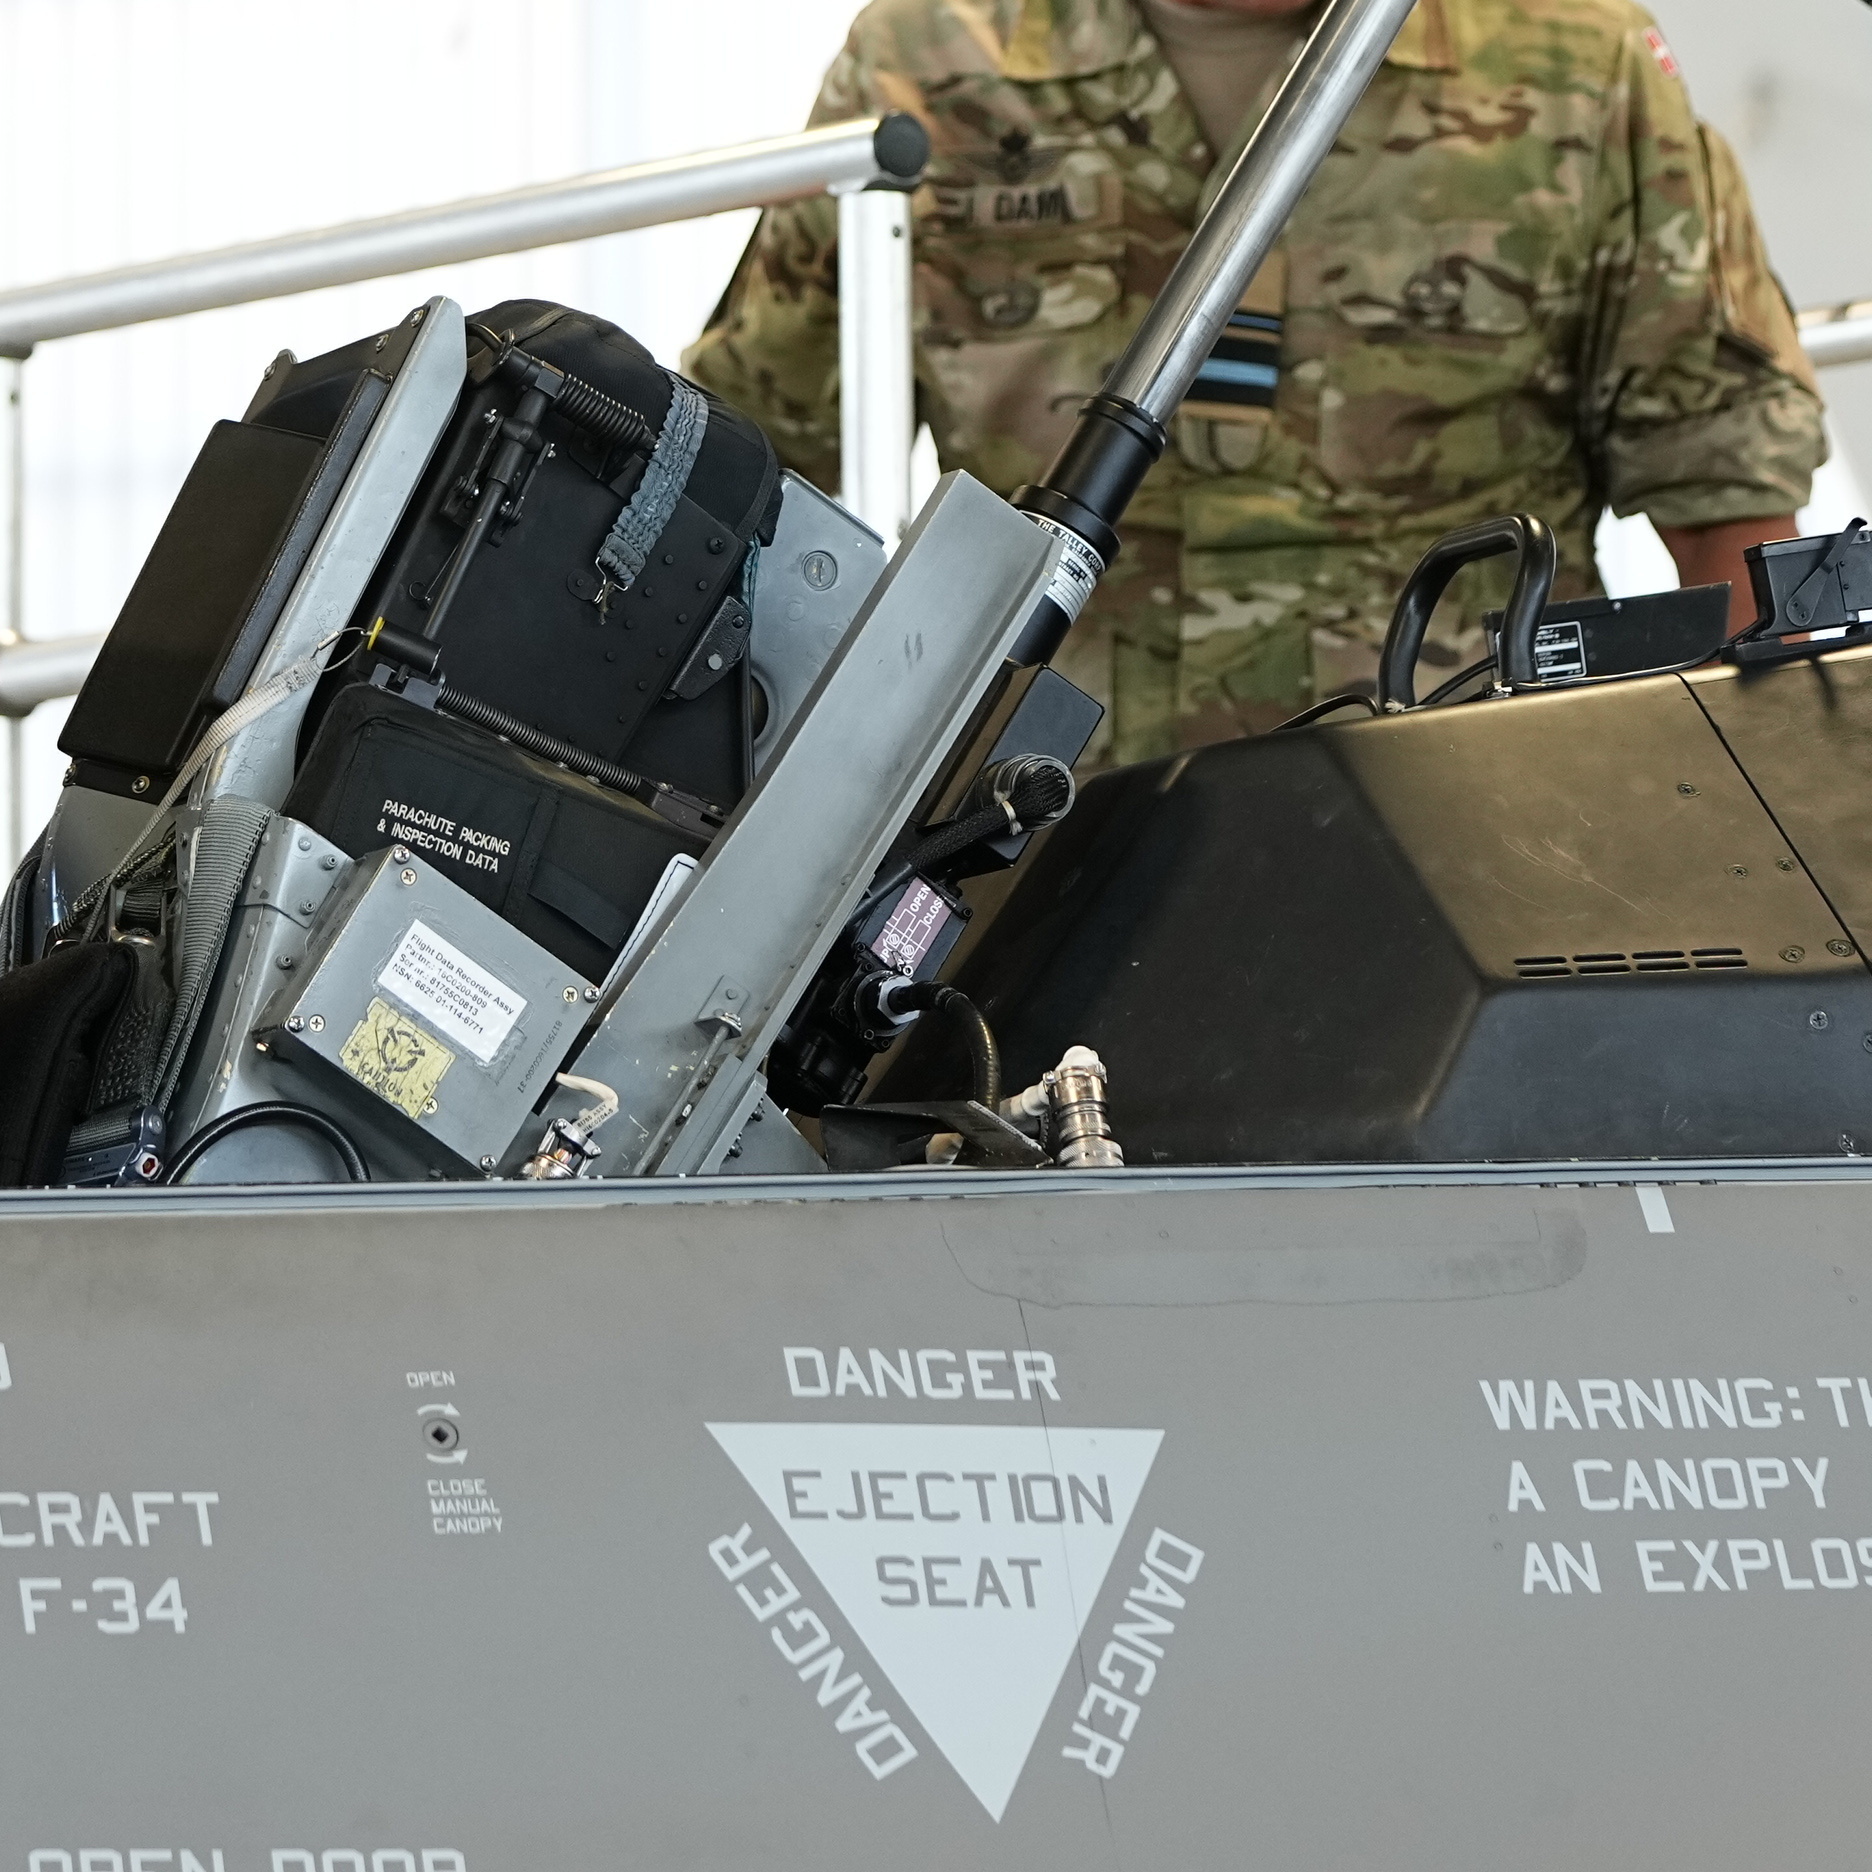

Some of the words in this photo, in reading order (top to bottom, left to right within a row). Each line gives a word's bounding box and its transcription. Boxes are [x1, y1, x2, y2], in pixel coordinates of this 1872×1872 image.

[1037, 519, 1055, 533] THE
[1059, 530, 1088, 554] TALLEY
[376, 818, 387, 834] &
[391, 822, 463, 860] INSPECTION
[465, 849, 499, 874] DATA
[382, 799, 456, 836] PARACHUTE
[459, 826, 511, 856] PACKING
[910, 883, 932, 913] OPEN
[392, 963, 414, 983] NSN:
[410, 933, 435, 957] Flight
[435, 952, 455, 971] Data
[456, 967, 492, 1000] Recorder
[492, 996, 515, 1016] Assy
[406, 1370, 456, 1388] OPEN
[783, 1347, 1061, 1400] DANGER
[427, 1478, 487, 1496] CLOSE
[430, 1497, 500, 1515] MANUAL
[782, 1469, 1114, 1525] EJECTION
[1508, 1460, 1546, 1512] A
[1572, 1457, 1829, 1511] CANOPY
[433, 1516, 503, 1535] CANOPY
[875, 1556, 1042, 1609] SEAT
[1523, 1541, 1602, 1594] AN
[19, 1577, 188, 1634] F-34
[708, 1522, 918, 1781] DANGER
[1061, 1527, 1205, 1779] DANGER
